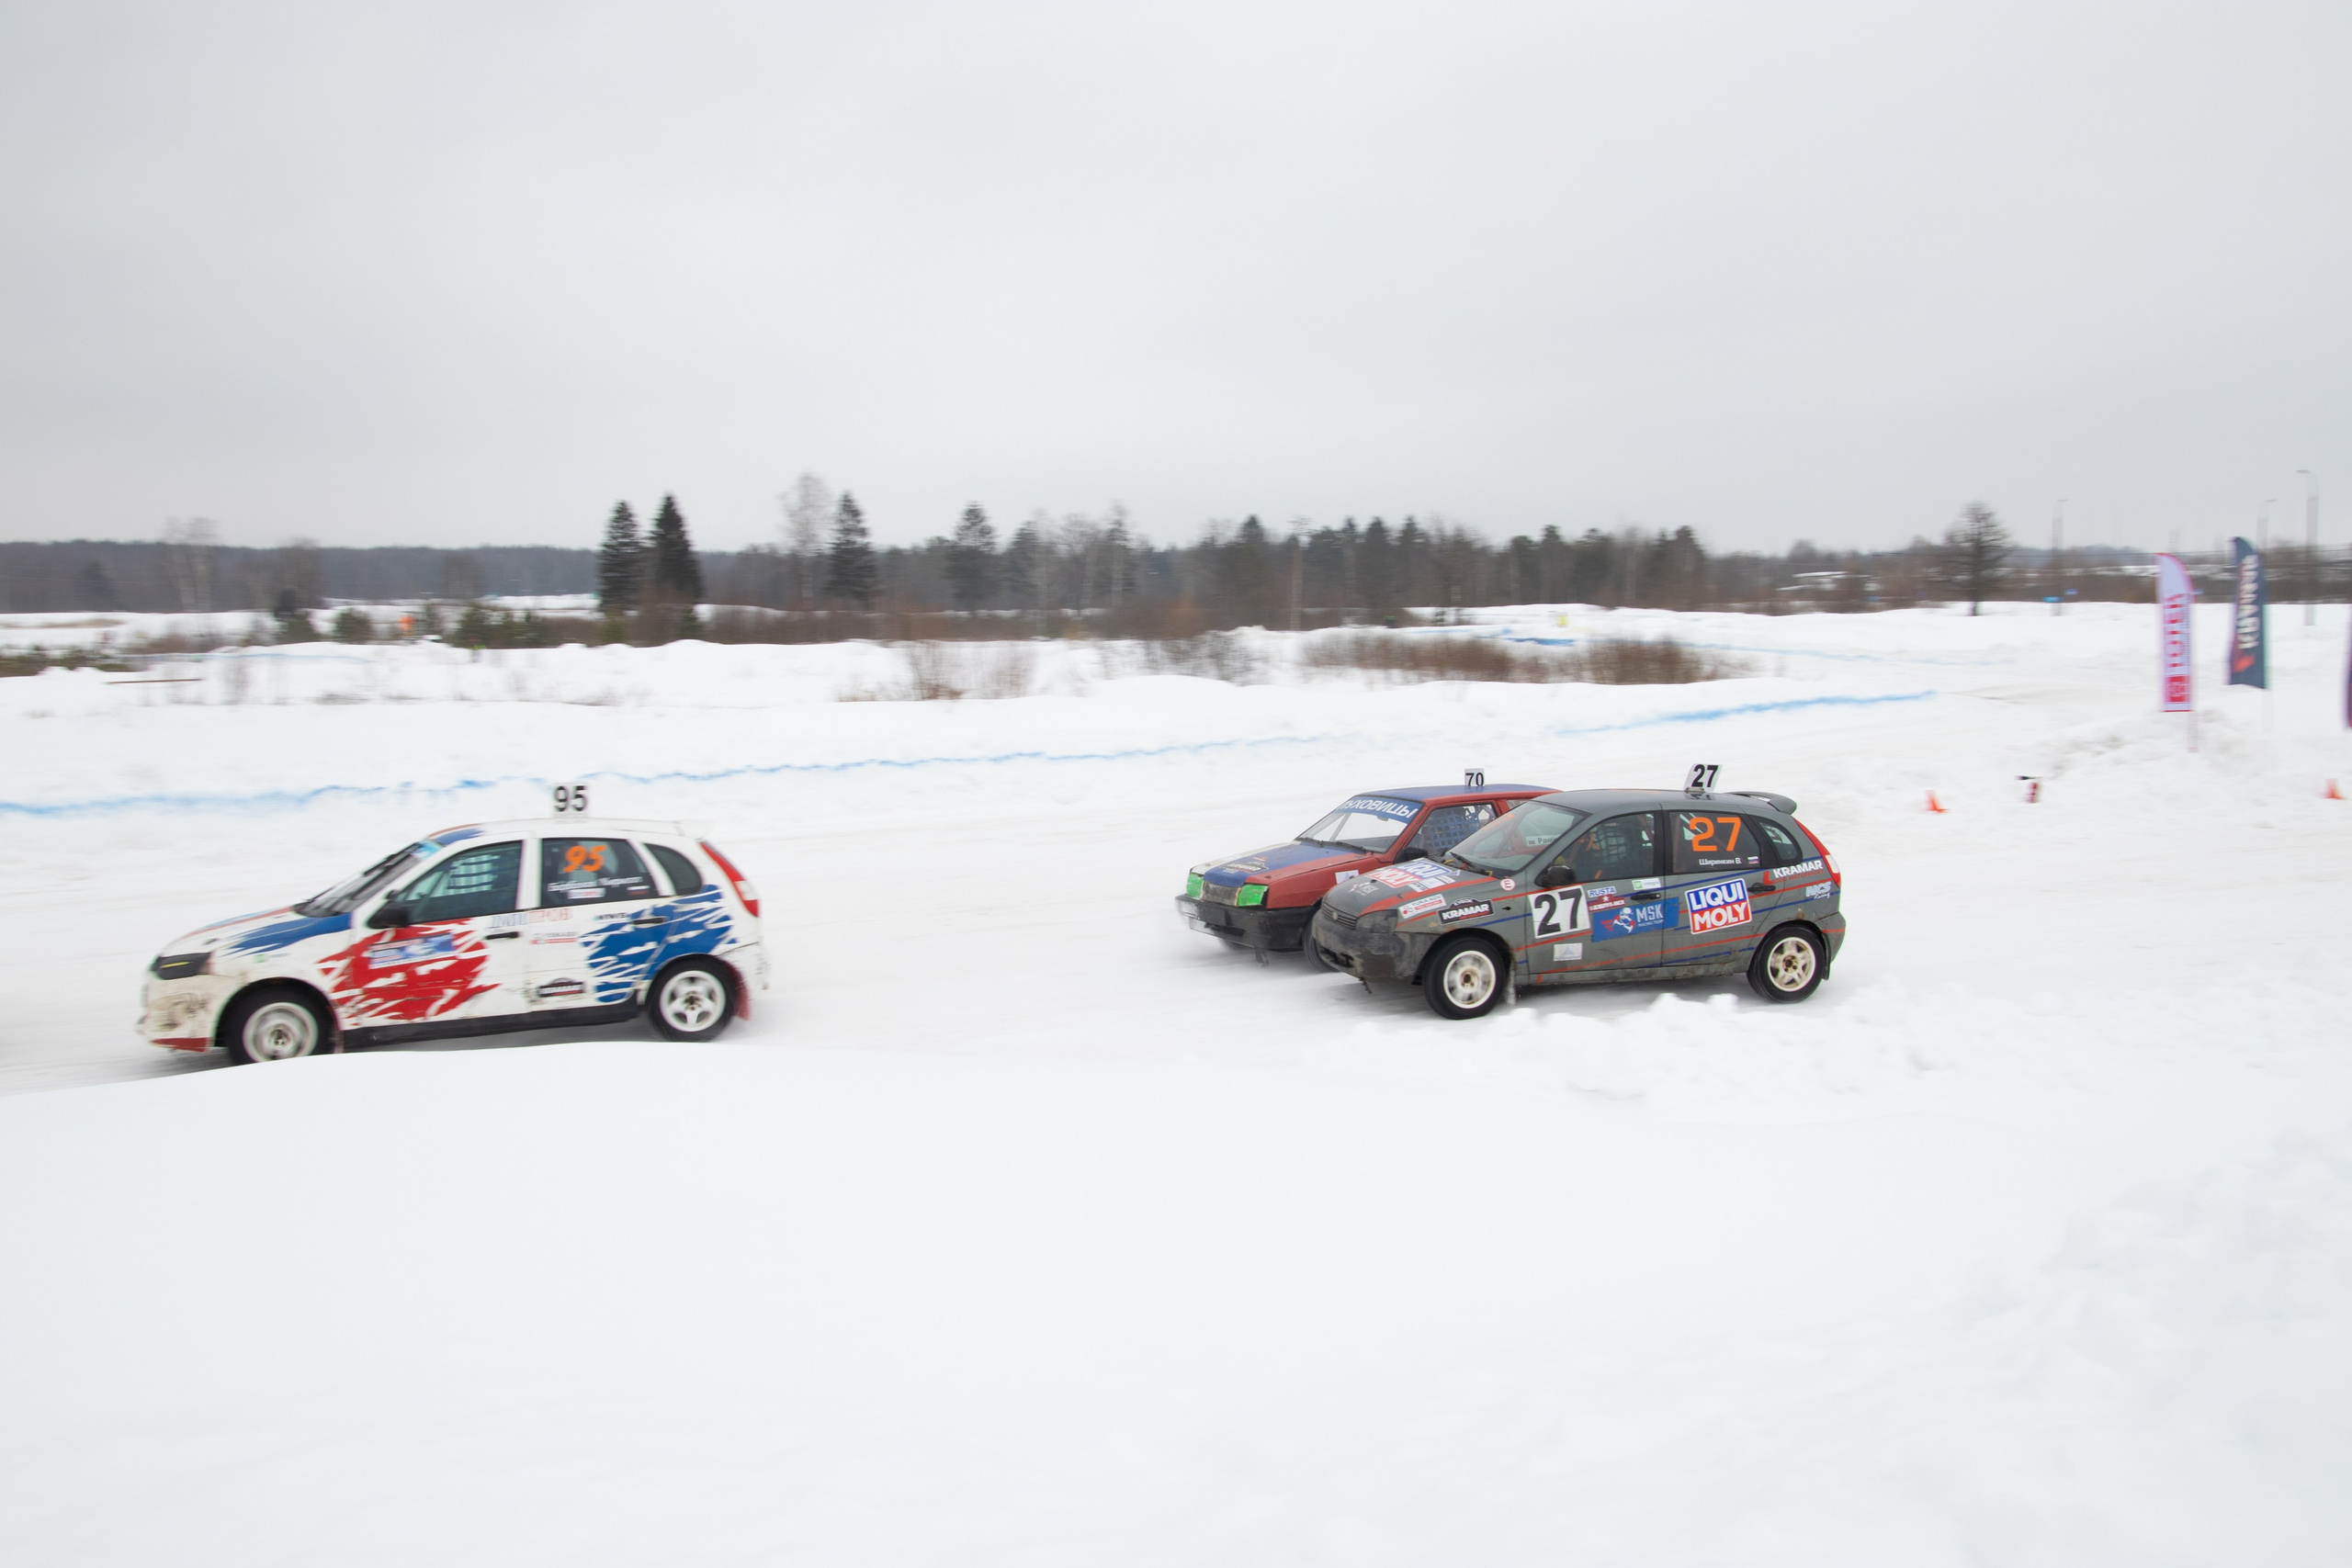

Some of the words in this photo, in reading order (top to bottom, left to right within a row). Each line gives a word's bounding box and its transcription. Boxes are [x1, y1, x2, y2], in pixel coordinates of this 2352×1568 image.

[1465, 772, 1485, 787] 70
[1691, 764, 1719, 787] 27
[554, 784, 588, 813] 95
[1689, 817, 1741, 852] 27
[563, 844, 609, 874] 95
[1772, 860, 1824, 878] KRAMAR
[1589, 886, 1616, 897] RUSTA
[1689, 881, 1746, 911] LIQUI
[1442, 904, 1490, 920] KRAMAR
[1534, 889, 1583, 936] 27
[1635, 904, 1665, 923] MSK
[1692, 903, 1749, 931] MOLY
